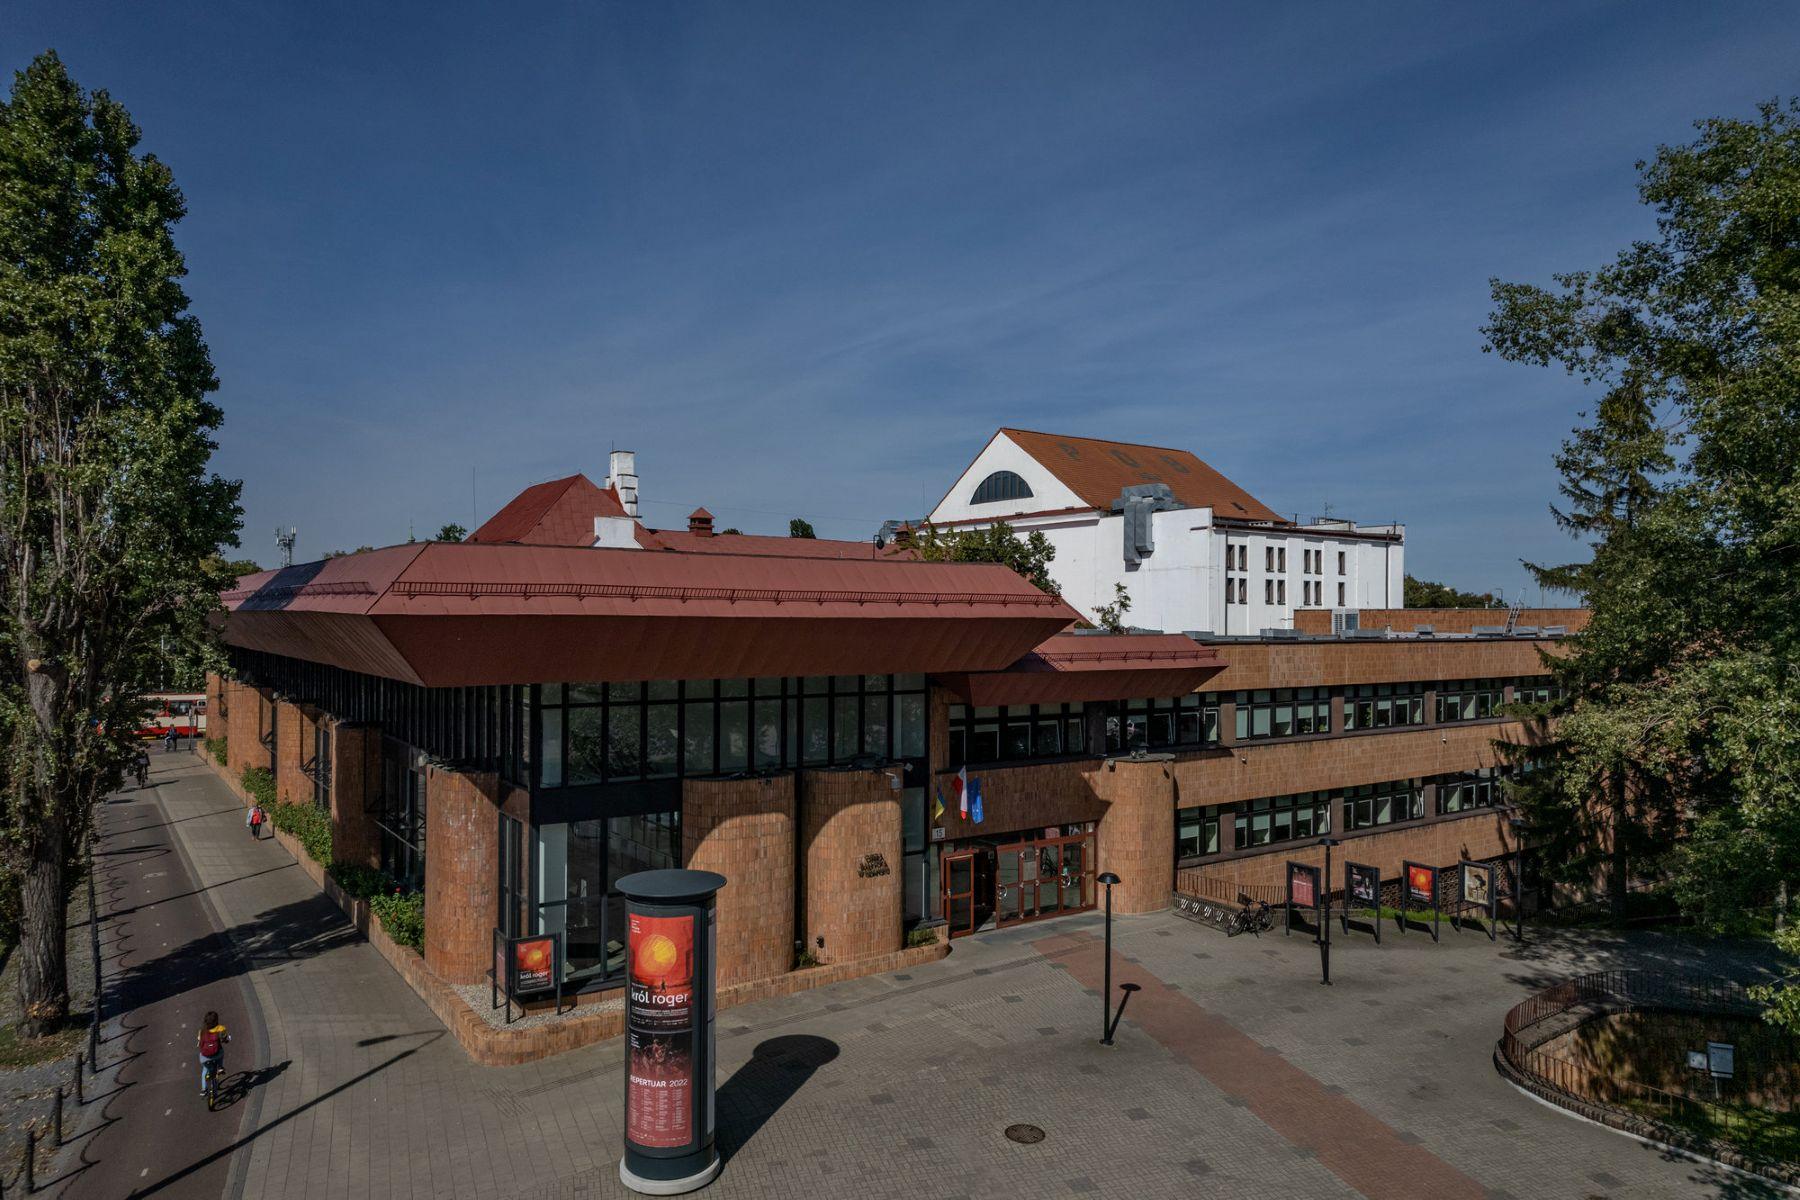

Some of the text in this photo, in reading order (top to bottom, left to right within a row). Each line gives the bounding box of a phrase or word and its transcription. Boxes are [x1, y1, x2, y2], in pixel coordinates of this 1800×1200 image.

[936, 829, 943, 838] 15
[631, 987, 688, 1007] król roger
[669, 1079, 688, 1088] 2022
